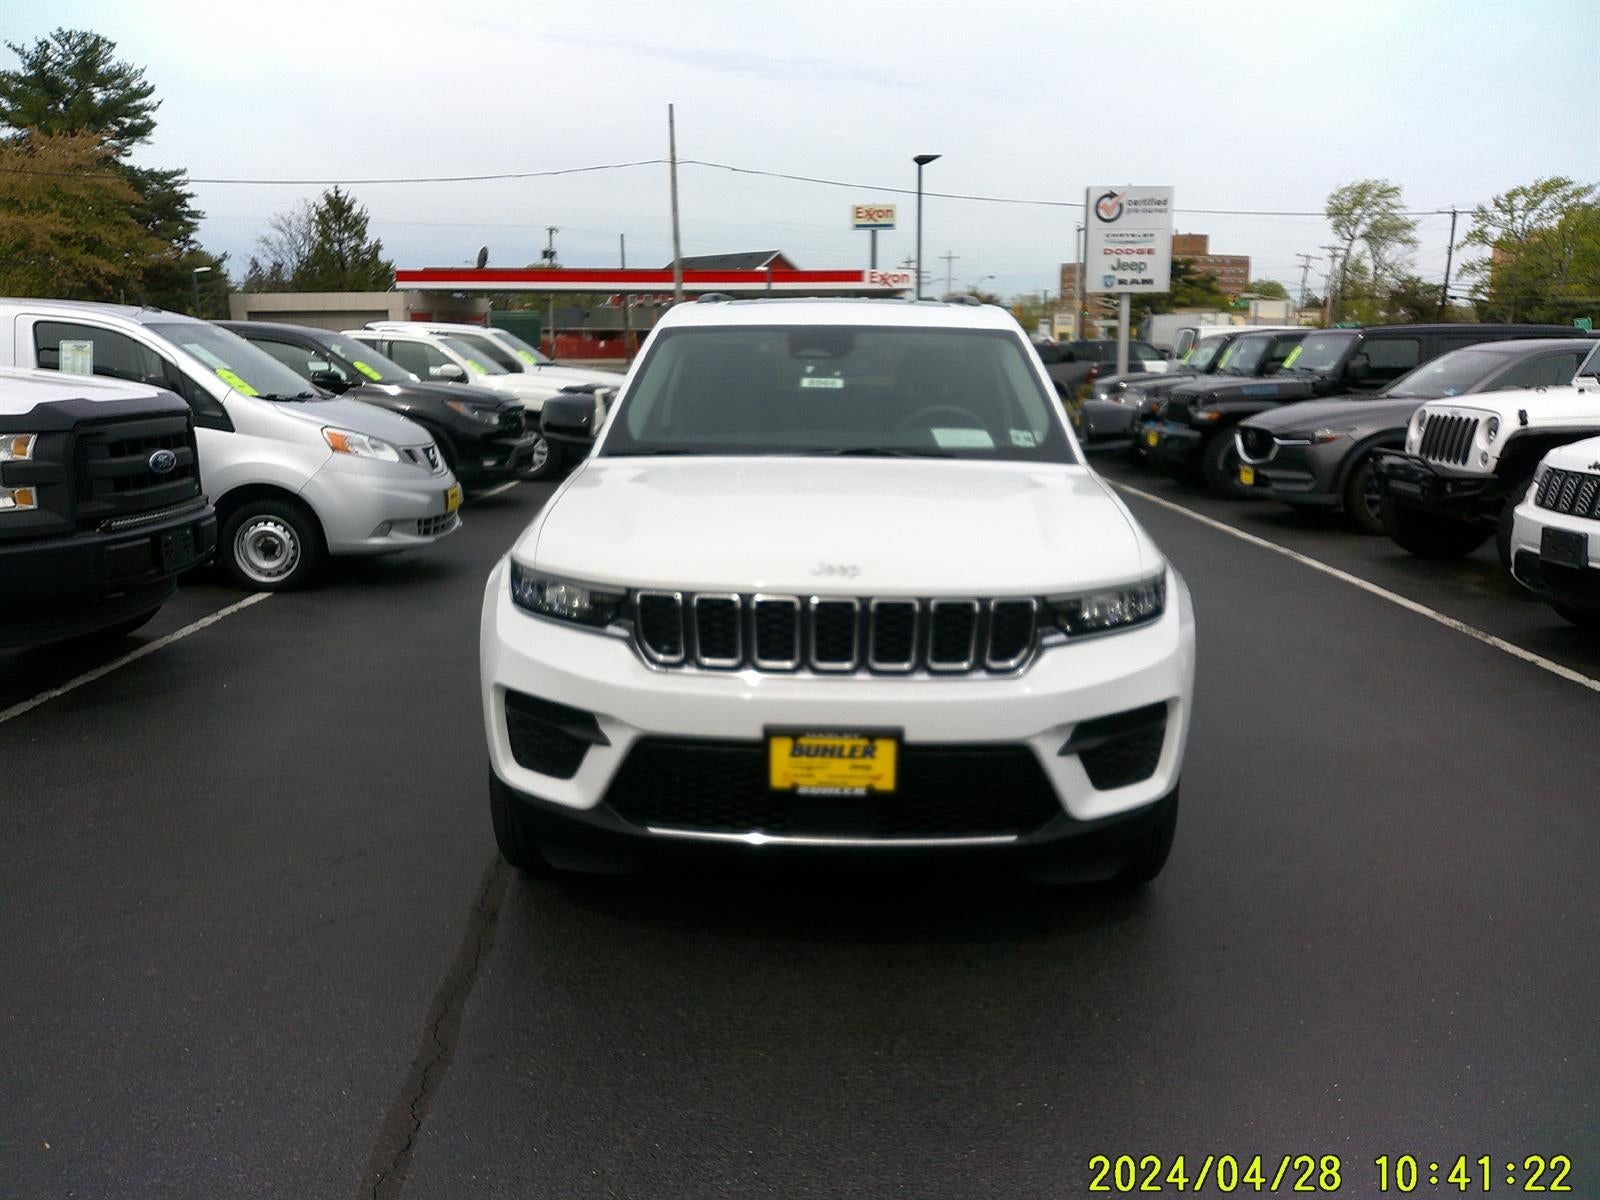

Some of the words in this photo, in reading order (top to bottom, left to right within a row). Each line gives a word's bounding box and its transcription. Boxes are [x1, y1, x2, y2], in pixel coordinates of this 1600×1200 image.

[1103, 248, 1155, 256] DODGE
[1111, 258, 1147, 273] Jeep
[790, 743, 877, 759] BUHLER
